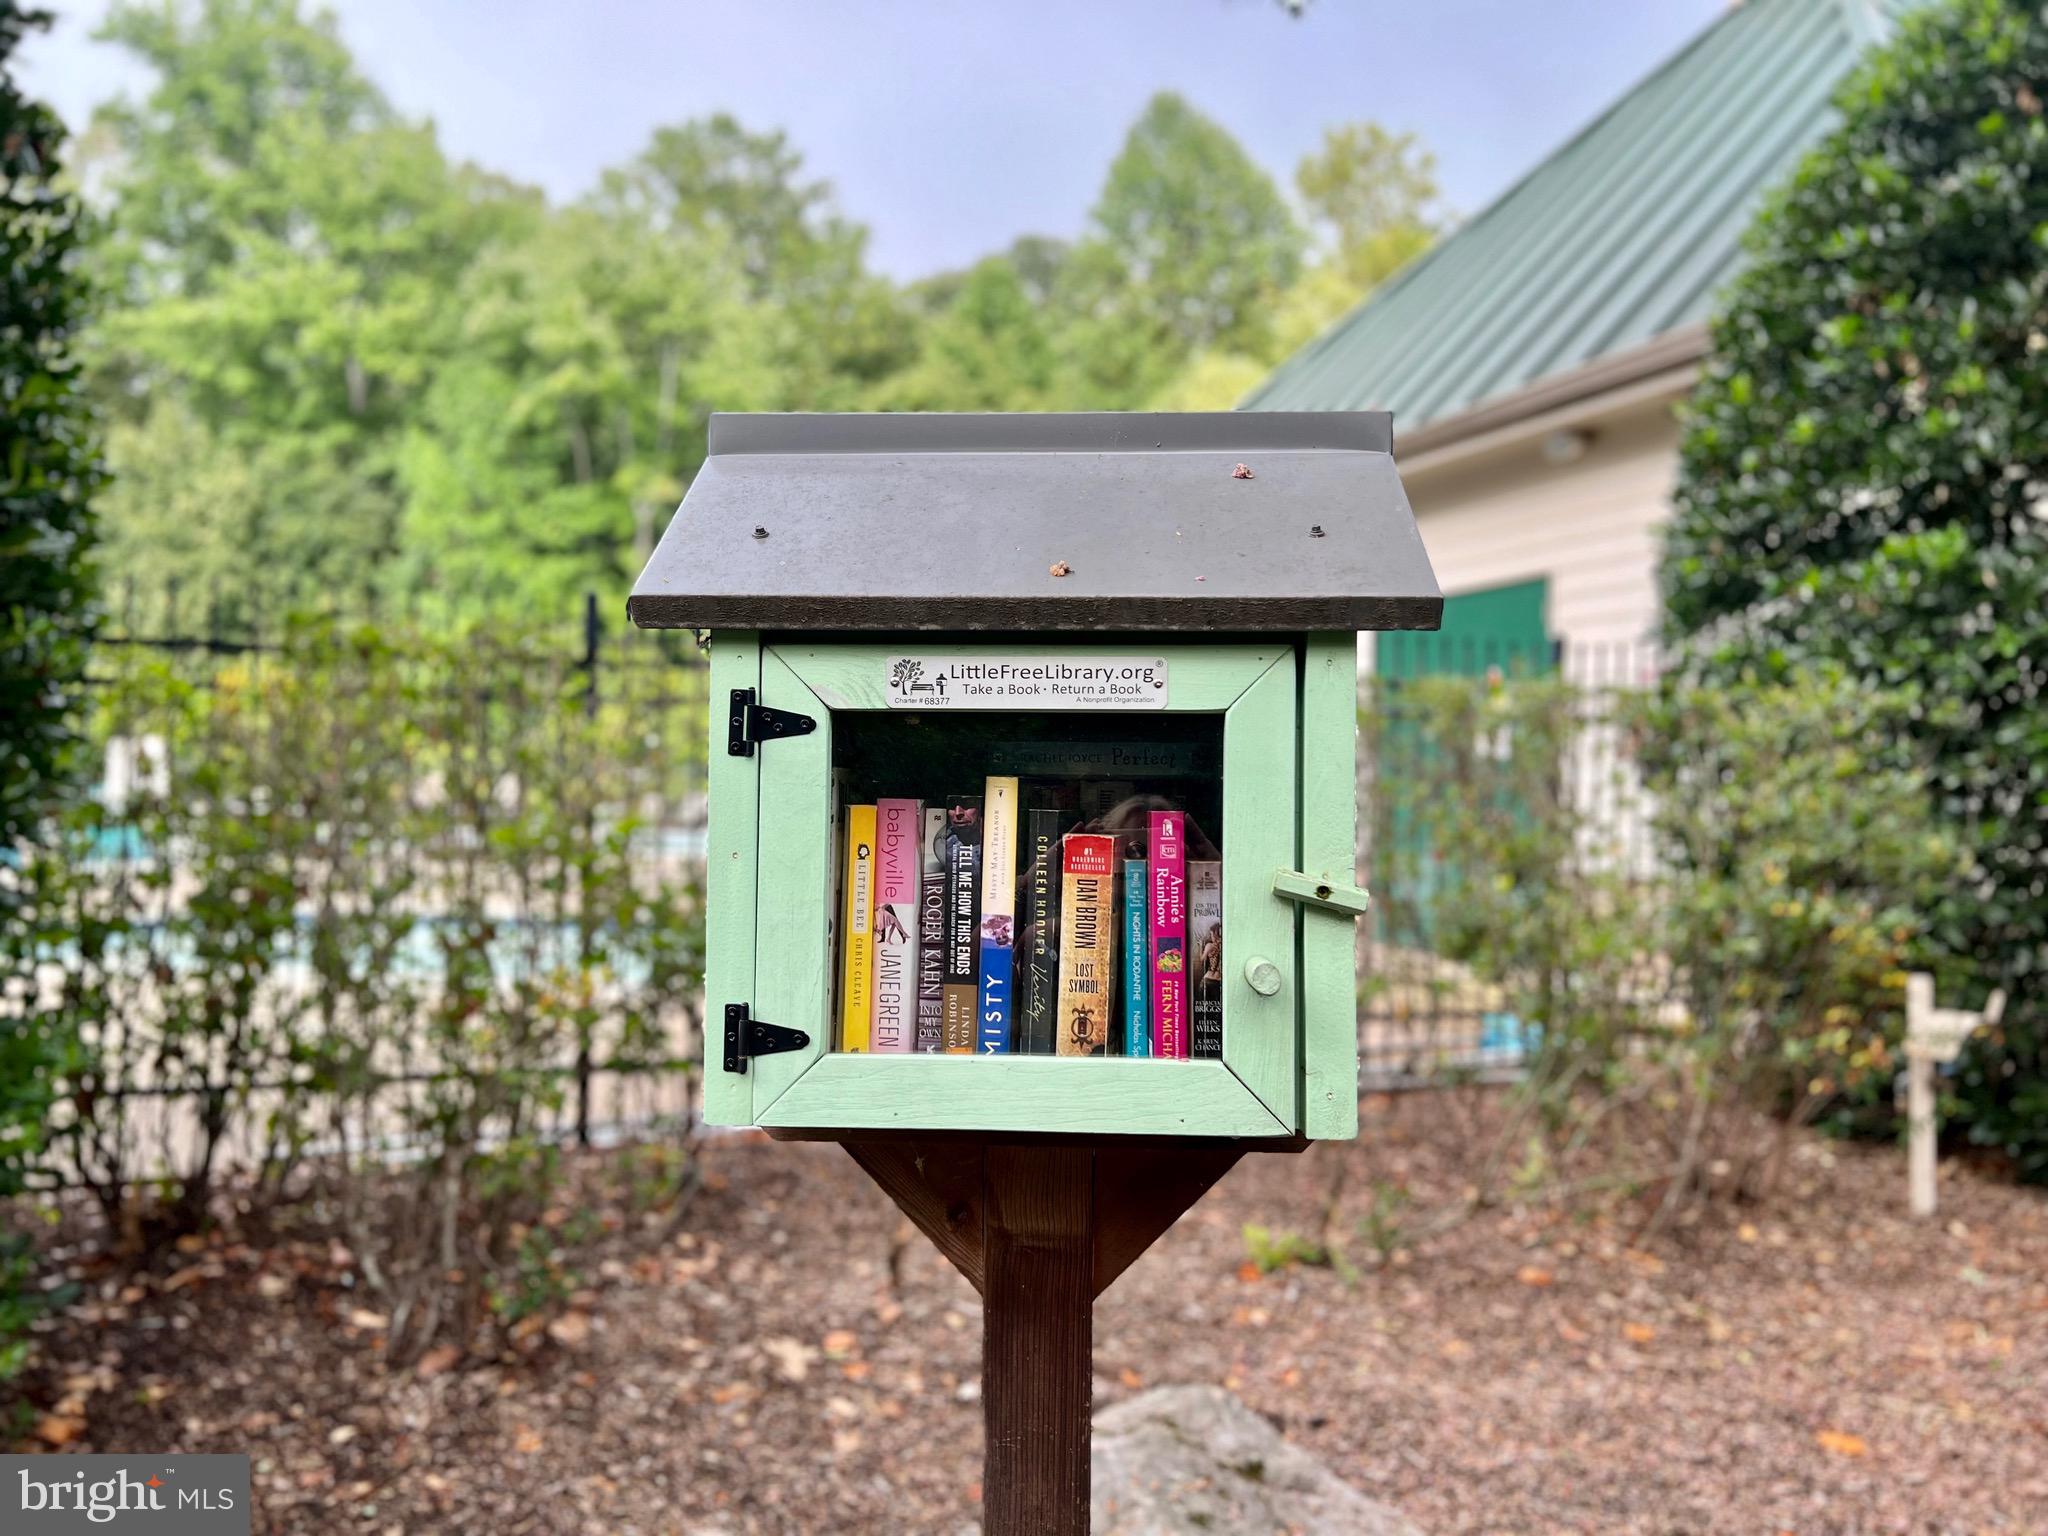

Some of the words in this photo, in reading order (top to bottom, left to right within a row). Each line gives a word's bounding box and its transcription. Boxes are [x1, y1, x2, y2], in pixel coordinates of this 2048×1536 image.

[951, 664, 1154, 682] LittleFreeLibrary.org
[963, 684, 992, 695] Take
[997, 686, 1004, 695] a
[1009, 684, 1041, 695] Book
[1052, 684, 1095, 695] Return
[1099, 686, 1106, 695] a
[1111, 684, 1142, 695] Book
[1111, 748, 1176, 767] Perfect
[881, 808, 906, 897] babyville
[959, 845, 973, 868] TELL
[1036, 836, 1048, 894] COLLEEN
[857, 865, 866, 902] LITTLE
[959, 872, 972, 888] ME
[1076, 879, 1098, 902] DAN
[925, 885, 943, 941] ROGER
[958, 892, 972, 916] HOW
[1157, 868, 1169, 927] Rainbow
[1171, 875, 1183, 923] Annie's
[1194, 909, 1221, 918] PROWL
[856, 909, 865, 928] BEE
[957, 919, 971, 943] THIS
[1035, 900, 1047, 955] HOOVER
[1075, 907, 1097, 949] BROWN
[1132, 912, 1142, 943] NIGHTS
[855, 938, 864, 967] CHRIS
[956, 946, 970, 975] ENDS
[1132, 944, 1141, 954] IN
[879, 949, 901, 990] JANE
[924, 949, 941, 996] KAHN
[1075, 963, 1094, 977] LOST
[1133, 956, 1142, 1000] RODANTHE
[853, 972, 863, 1007] CLEAVE
[1026, 963, 1048, 1022] Verity
[1069, 979, 1099, 993] SYMBOL
[1162, 980, 1172, 1013] FERN
[878, 993, 900, 1047] GREEN
[920, 1005, 942, 1015] INTO
[923, 1017, 937, 1026] MY
[948, 994, 957, 1048] ROBINSO
[961, 1006, 970, 1045] LINDA
[984, 974, 1003, 1056] MISTY
[919, 1028, 941, 1038] OWN
[1133, 1010, 1142, 1044] Nicholas
[1162, 1017, 1173, 1059] MICHA
[1132, 1046, 1142, 1057] Sp
